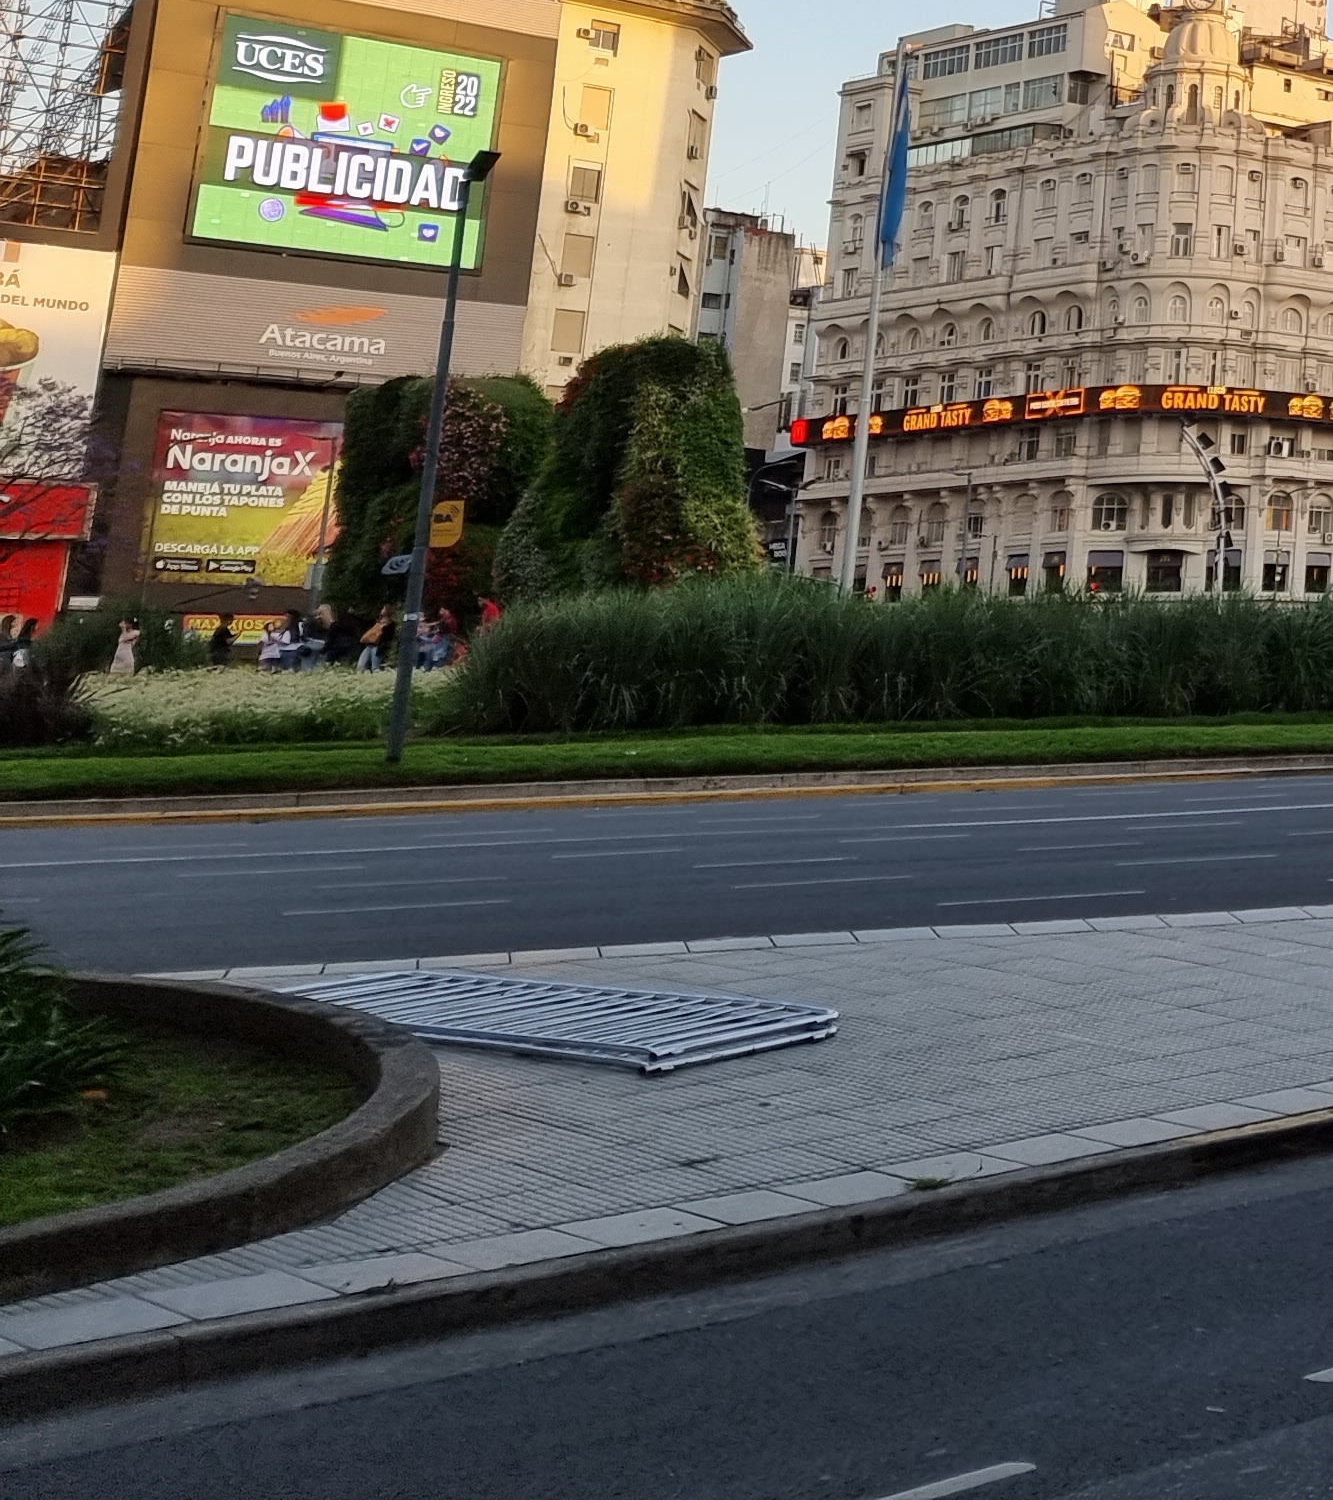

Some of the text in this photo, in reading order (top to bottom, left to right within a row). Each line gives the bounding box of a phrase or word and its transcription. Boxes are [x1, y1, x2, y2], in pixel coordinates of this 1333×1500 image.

[235, 41, 325, 78] UCES
[437, 70, 457, 115] INGRESO
[457, 75, 479, 97] 20
[454, 94, 477, 117] 22
[223, 135, 468, 211] PUBLICIDAD
[0, 294, 90, 312] DEL MUNDO
[258, 323, 386, 355] Atacama
[329, 354, 373, 365] Argentina
[1161, 392, 1266, 413] GRAND TASTY
[903, 413, 938, 431] GRAND
[940, 408, 973, 427] TASTY
[226, 436, 267, 447] AHORA
[268, 437, 283, 447] ES
[164, 480, 283, 497] MANEJÁ TU PLATA
[161, 504, 227, 517] DE PUNTA
[162, 492, 285, 508] CON LOS TAPONES
[155, 543, 260, 556] DESCARGÁ LA APP
